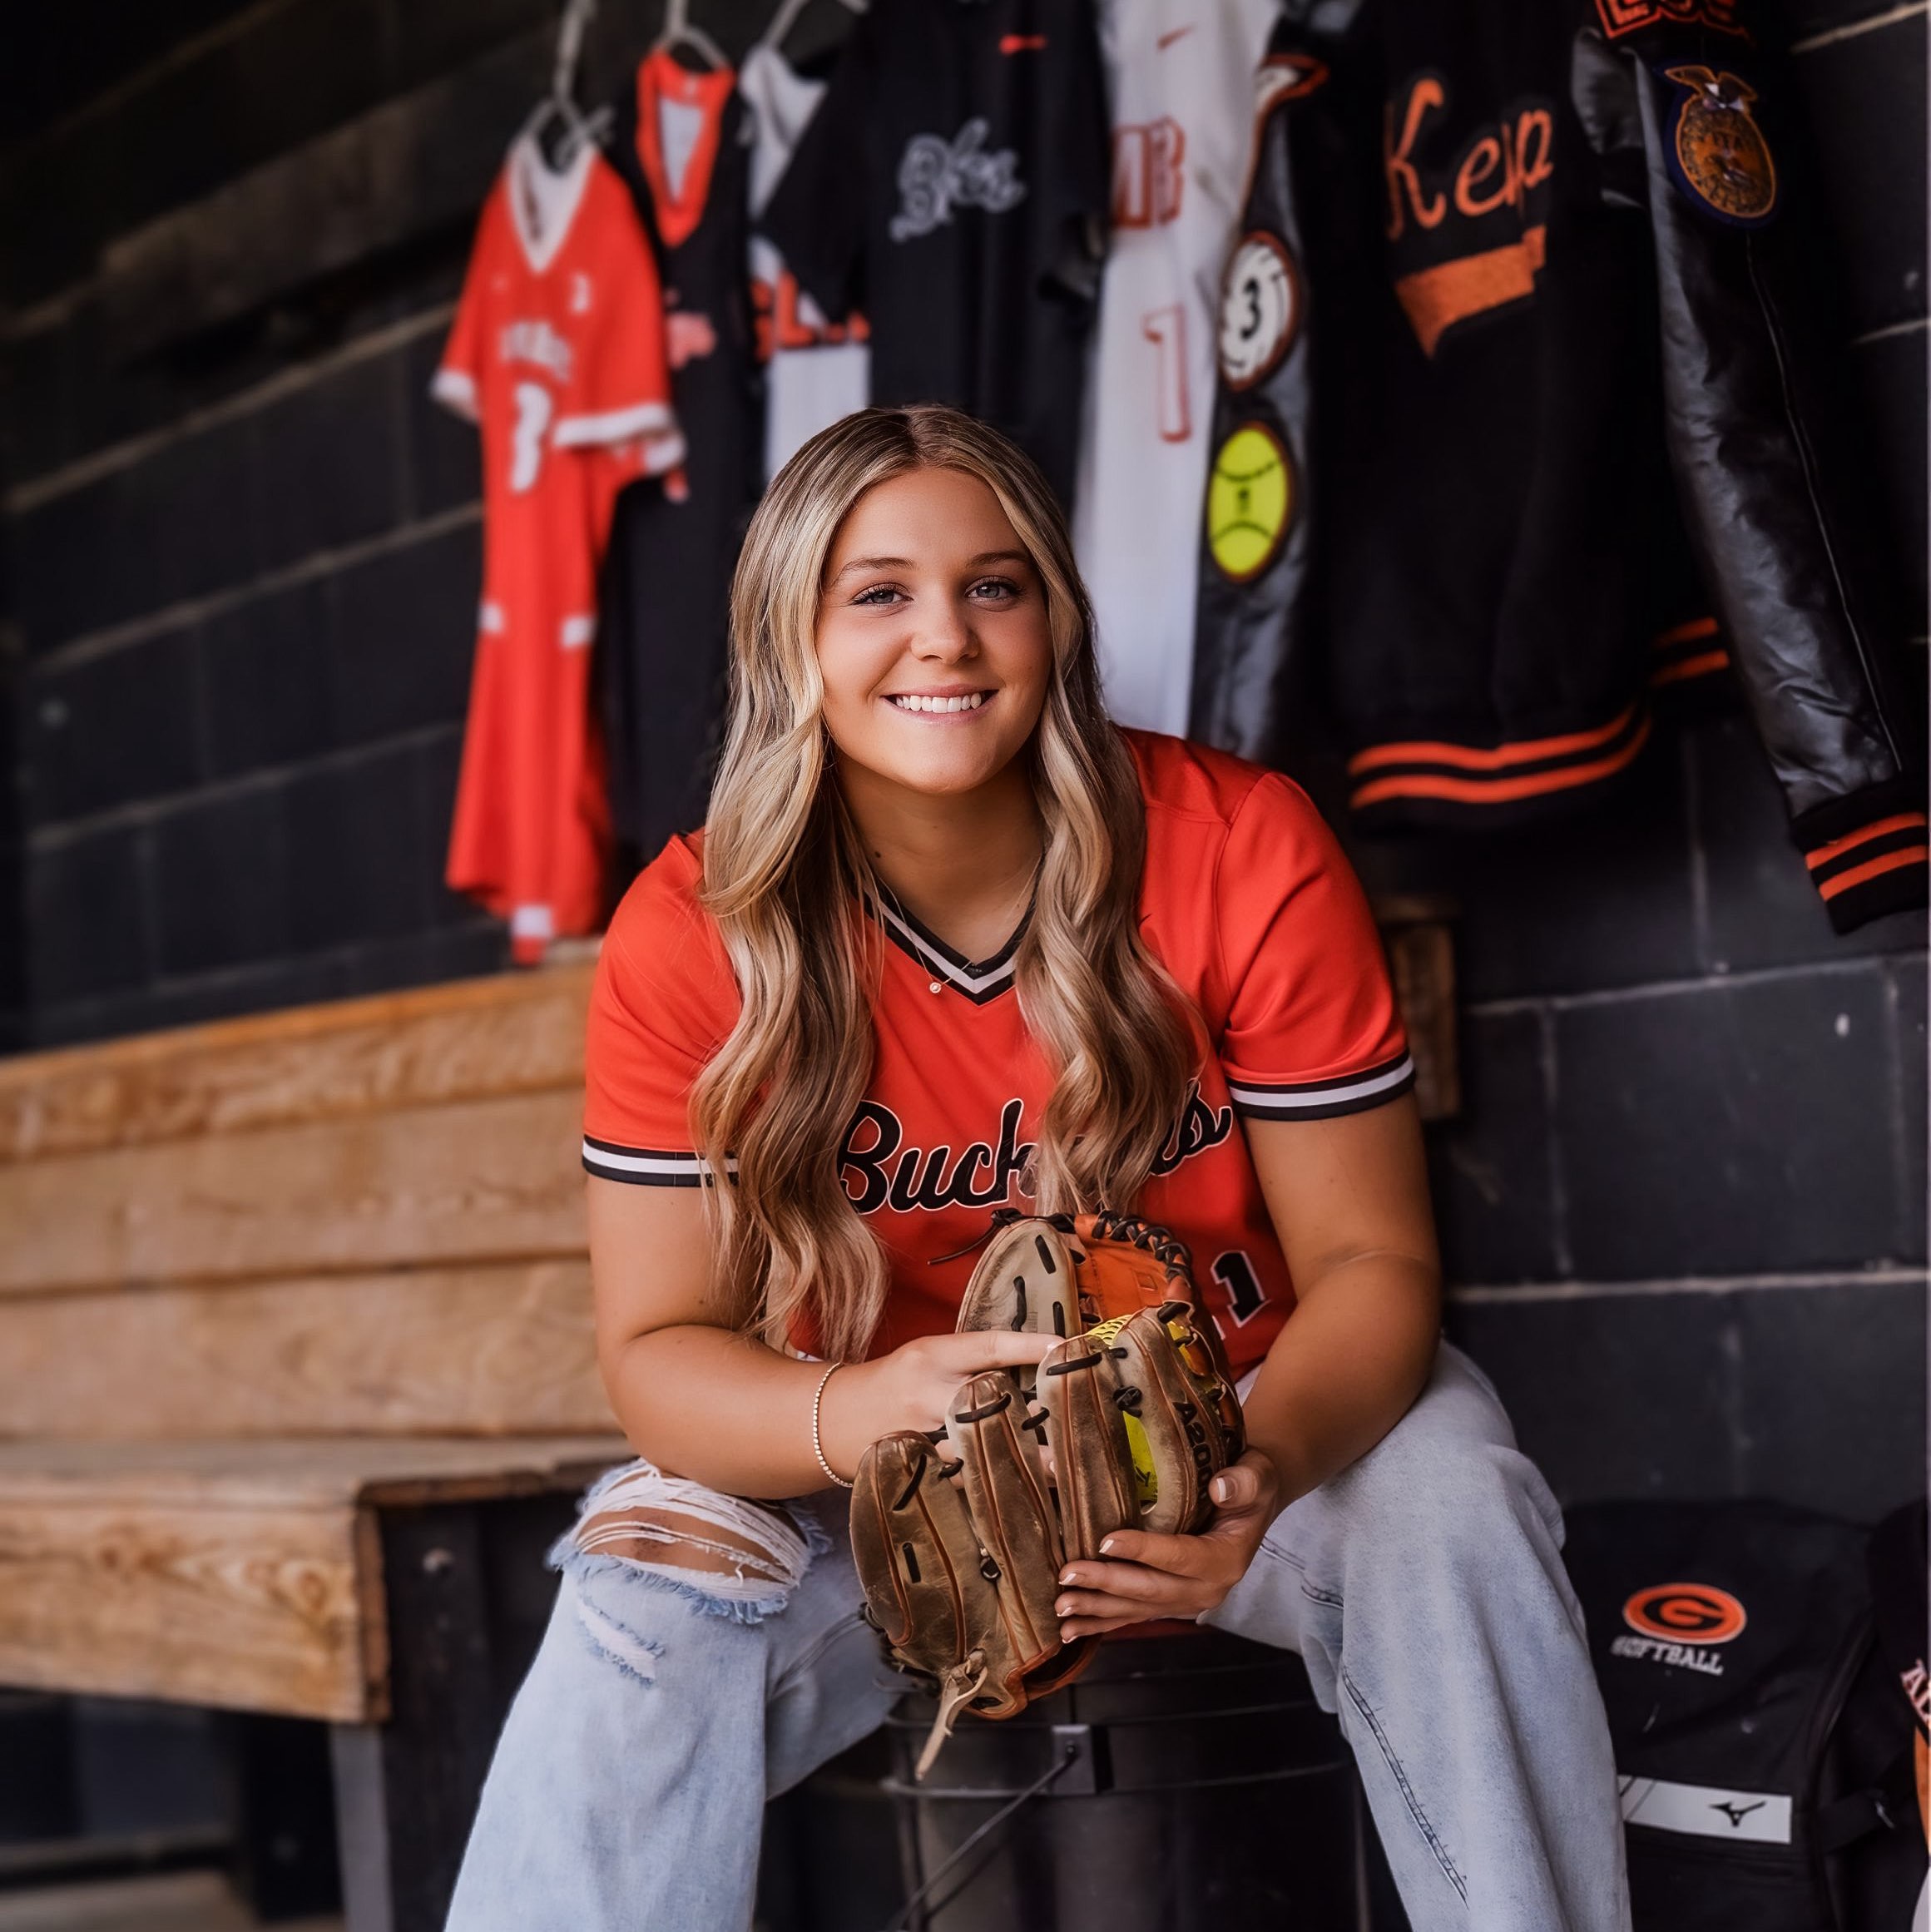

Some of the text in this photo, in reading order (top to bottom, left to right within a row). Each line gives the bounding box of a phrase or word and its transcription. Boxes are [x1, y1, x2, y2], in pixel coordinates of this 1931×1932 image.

[1240, 277, 1261, 340] 3
[837, 1077, 1233, 1215] Bucks
[1611, 1635, 1724, 1677] SOFTBALL
